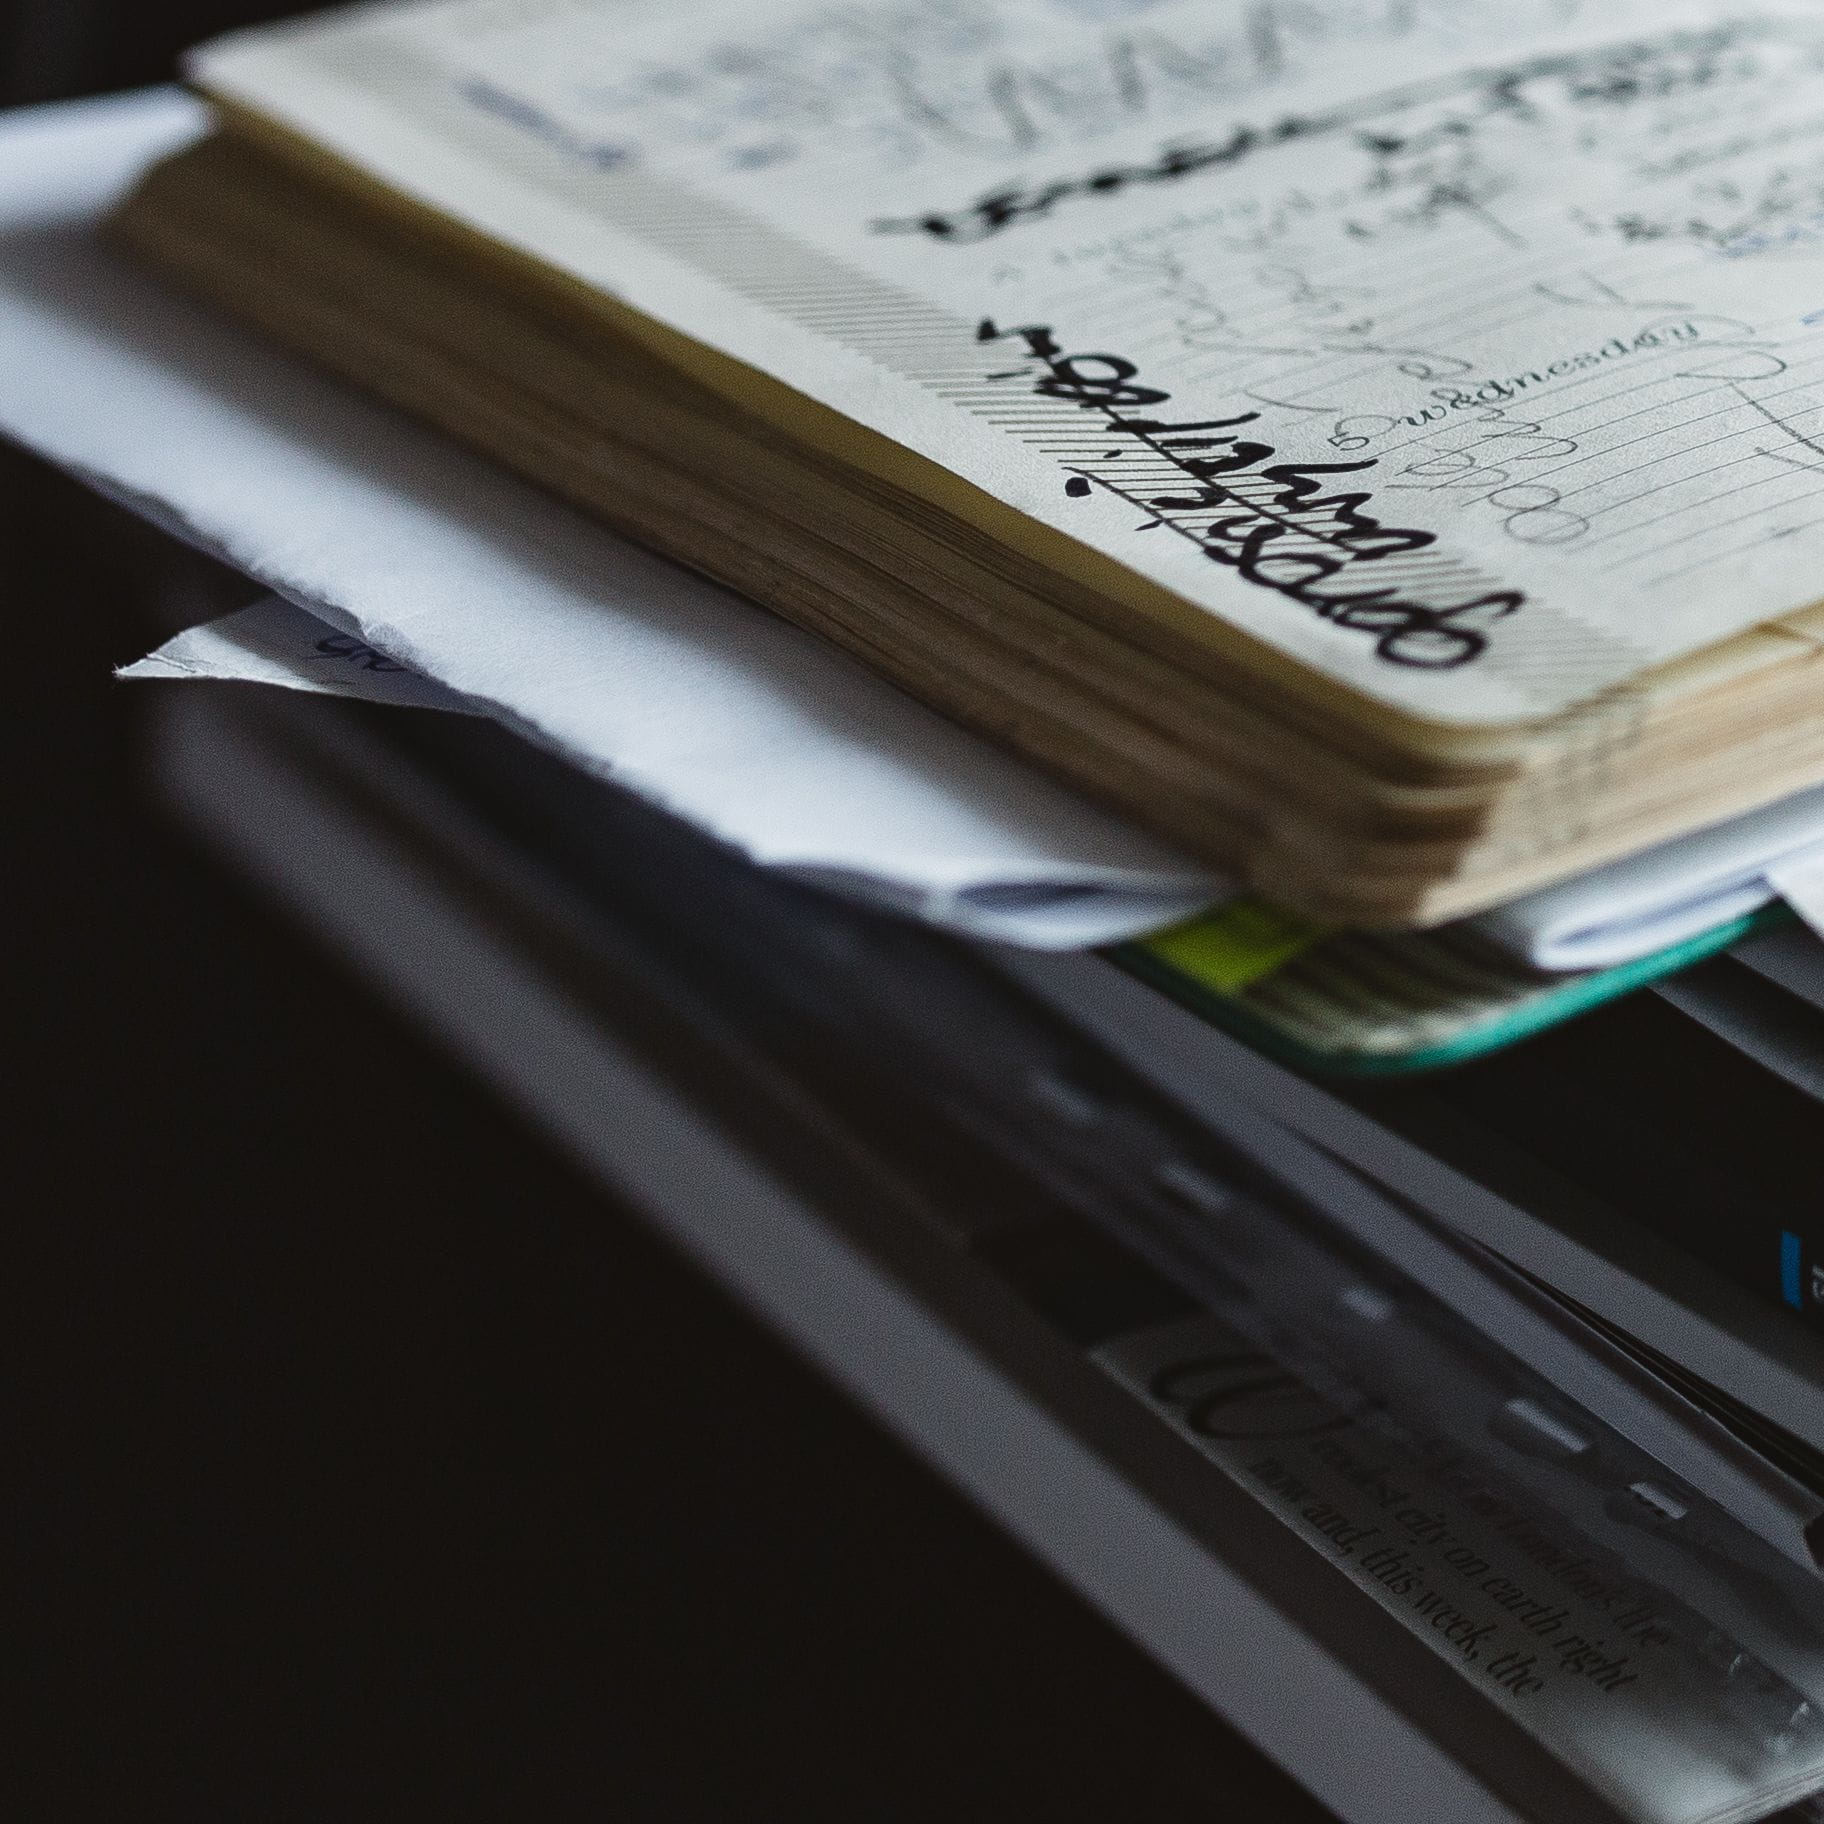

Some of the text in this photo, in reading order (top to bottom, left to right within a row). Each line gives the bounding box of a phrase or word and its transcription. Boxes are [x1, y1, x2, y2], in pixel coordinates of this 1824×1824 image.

[1250, 1456, 1546, 1697] now and, this week, the
[1394, 1493, 1458, 1550] city
[1444, 1532, 1485, 1580] on
[1480, 1568, 1563, 1638] earth
[1553, 1626, 1638, 1693] right
